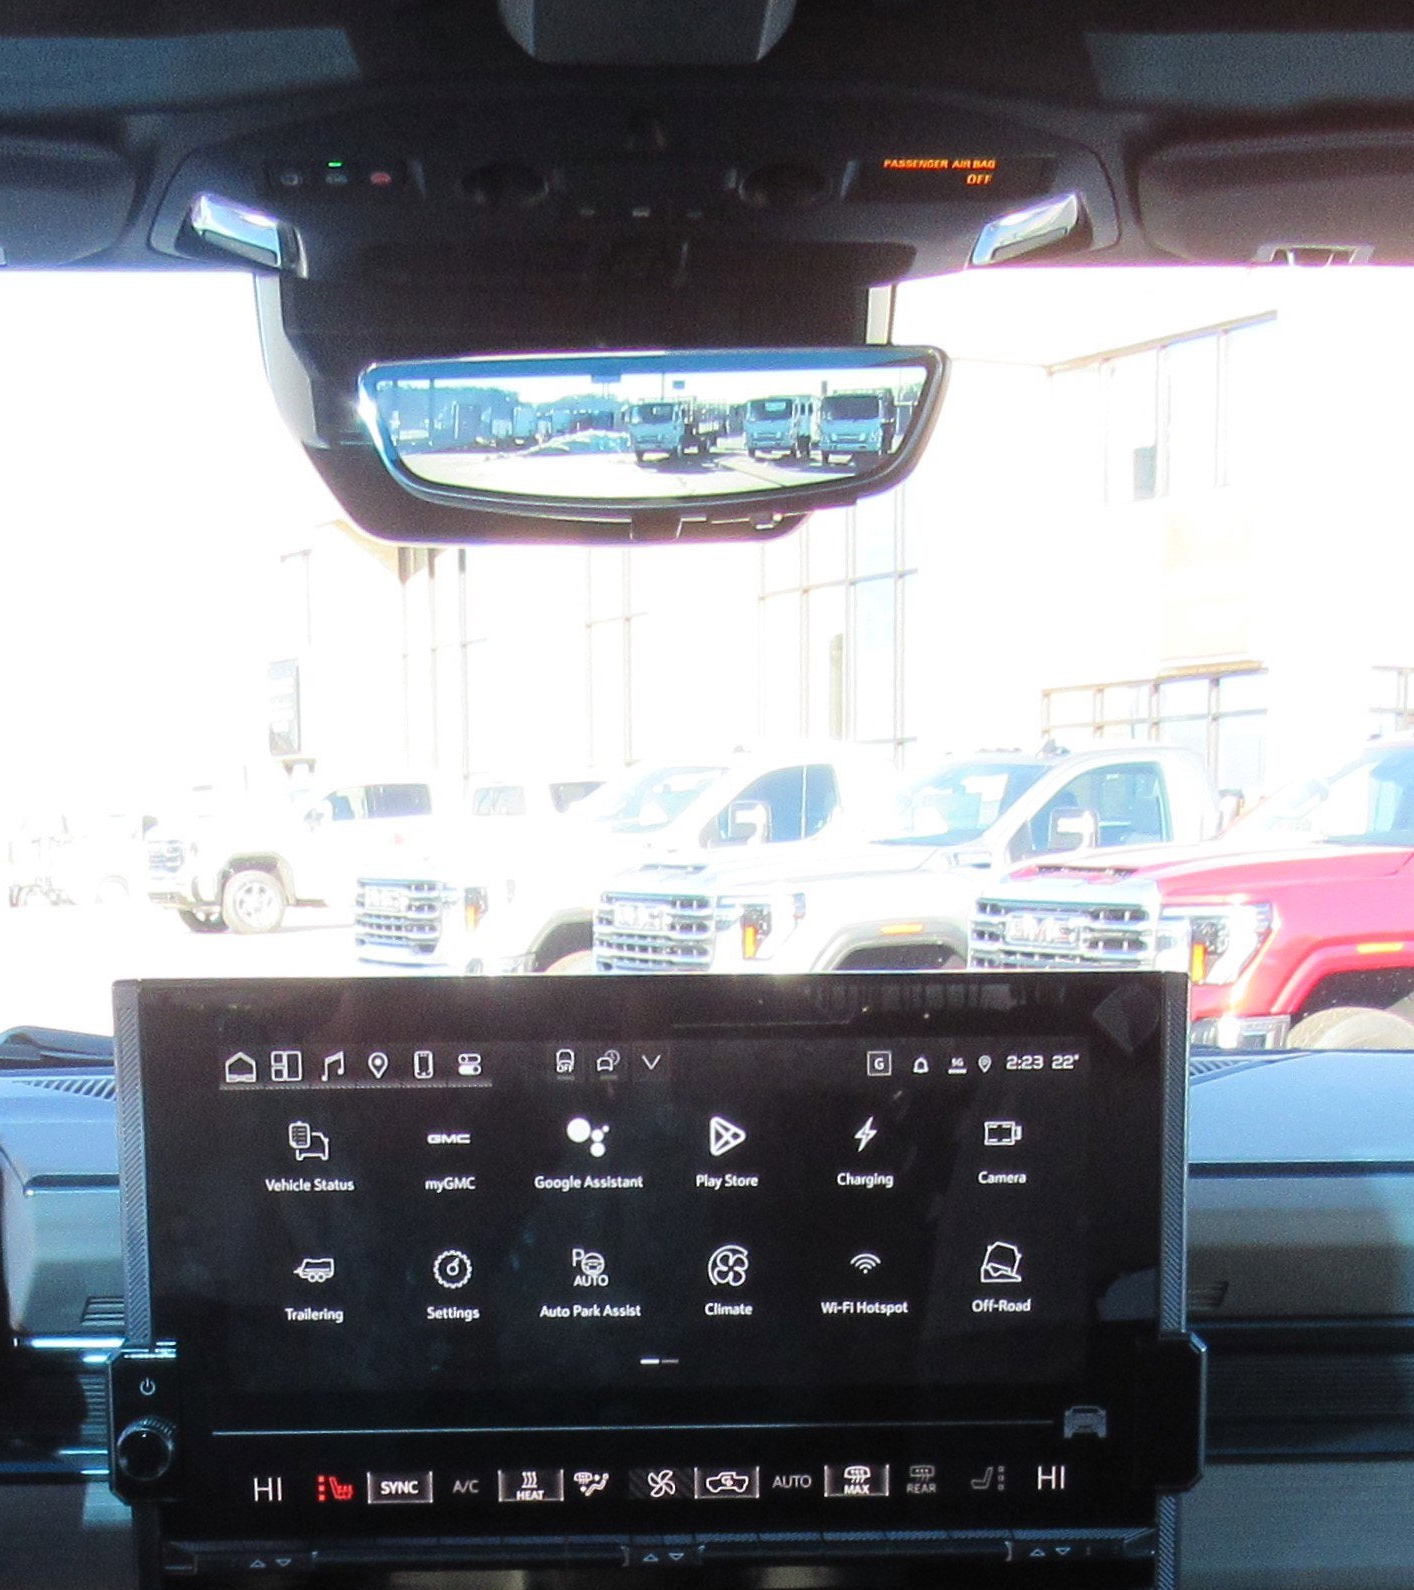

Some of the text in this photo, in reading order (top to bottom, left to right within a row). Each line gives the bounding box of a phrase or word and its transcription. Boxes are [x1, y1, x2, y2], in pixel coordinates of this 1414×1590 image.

[883, 158, 996, 169] PASSENGER AIR BAG
[967, 173, 993, 184] OFF
[1006, 1054, 1044, 1070] 2:23
[427, 1133, 471, 1144] GMC
[264, 1177, 355, 1192] Vehicle Status
[534, 1174, 644, 1192] Google Assistant
[695, 1173, 759, 1190] Play Store
[836, 1172, 894, 1189] Charging
[977, 1170, 1027, 1184] Camera
[424, 1176, 476, 1194] myGMC
[573, 1273, 609, 1287] AUTO
[539, 1303, 642, 1318] Auto Park Assist
[704, 1302, 753, 1316] Climate
[820, 1301, 909, 1317] Wi-Fi Hotspot
[971, 1298, 1032, 1313] Off-Road
[284, 1307, 344, 1324] Trailering
[426, 1306, 480, 1322] Settings
[771, 1474, 812, 1489] AUTO
[1037, 1465, 1065, 1490] HI
[253, 1476, 282, 1502] HI
[380, 1480, 419, 1495] SYNC
[452, 1479, 479, 1494] A/C
[843, 1484, 870, 1495] MAX
[906, 1482, 937, 1494] REAR
[514, 1489, 546, 1500] HEAT
